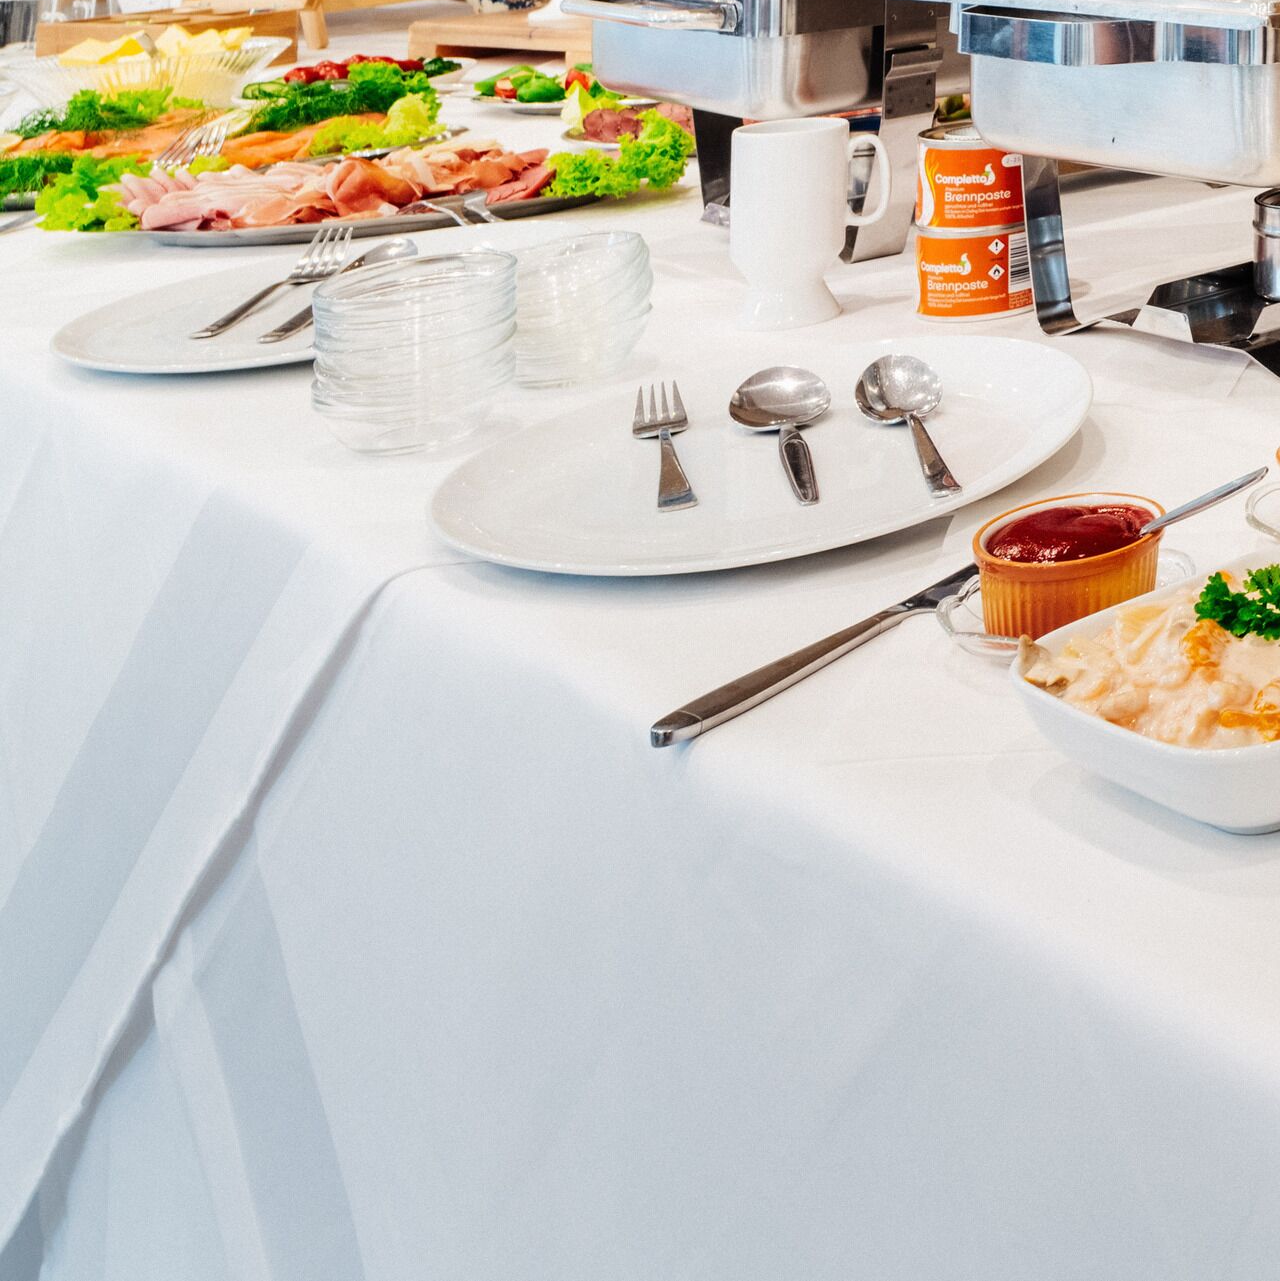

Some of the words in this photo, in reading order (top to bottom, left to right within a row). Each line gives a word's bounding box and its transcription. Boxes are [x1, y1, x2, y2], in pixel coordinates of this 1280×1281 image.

[935, 173, 987, 186] Completto
[944, 190, 1011, 203] Brennpaste
[920, 261, 964, 275] Completto
[927, 280, 989, 293] Brennpaste
